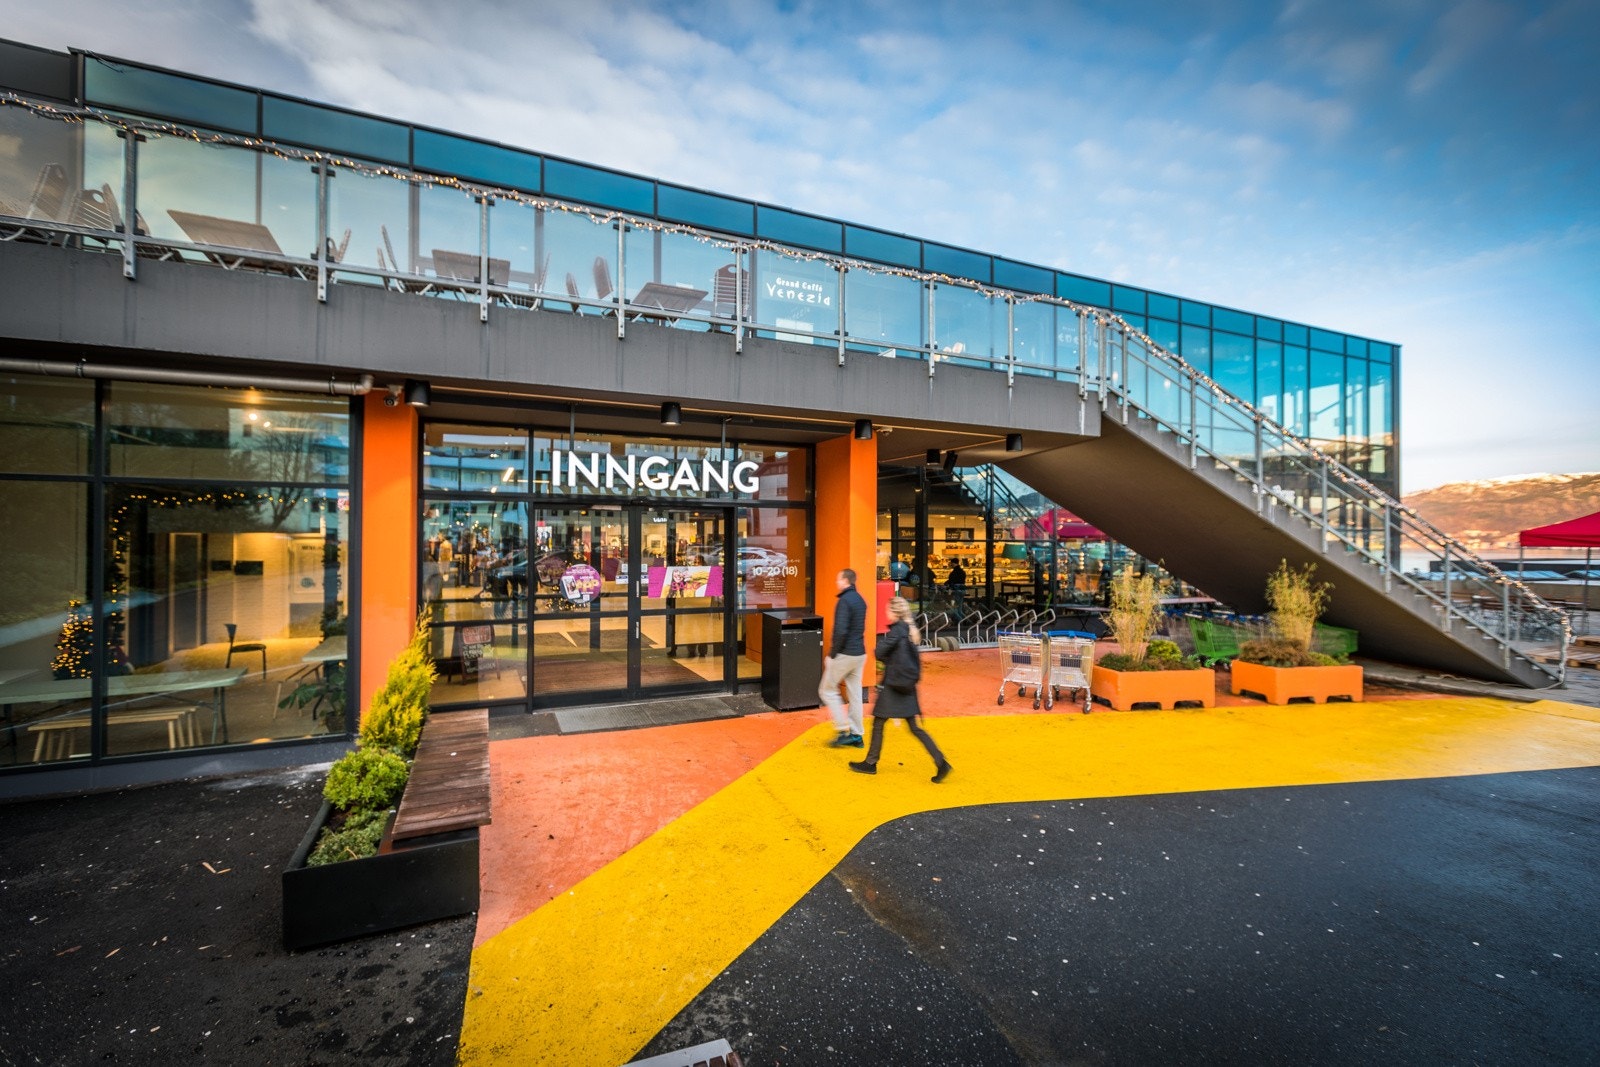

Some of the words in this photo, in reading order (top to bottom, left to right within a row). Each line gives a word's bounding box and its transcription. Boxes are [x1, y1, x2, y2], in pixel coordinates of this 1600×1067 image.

[776, 277, 800, 289] Grand
[766, 282, 831, 306] Venezia
[552, 450, 760, 494] INNGANG
[781, 565, 798, 578] (18)
